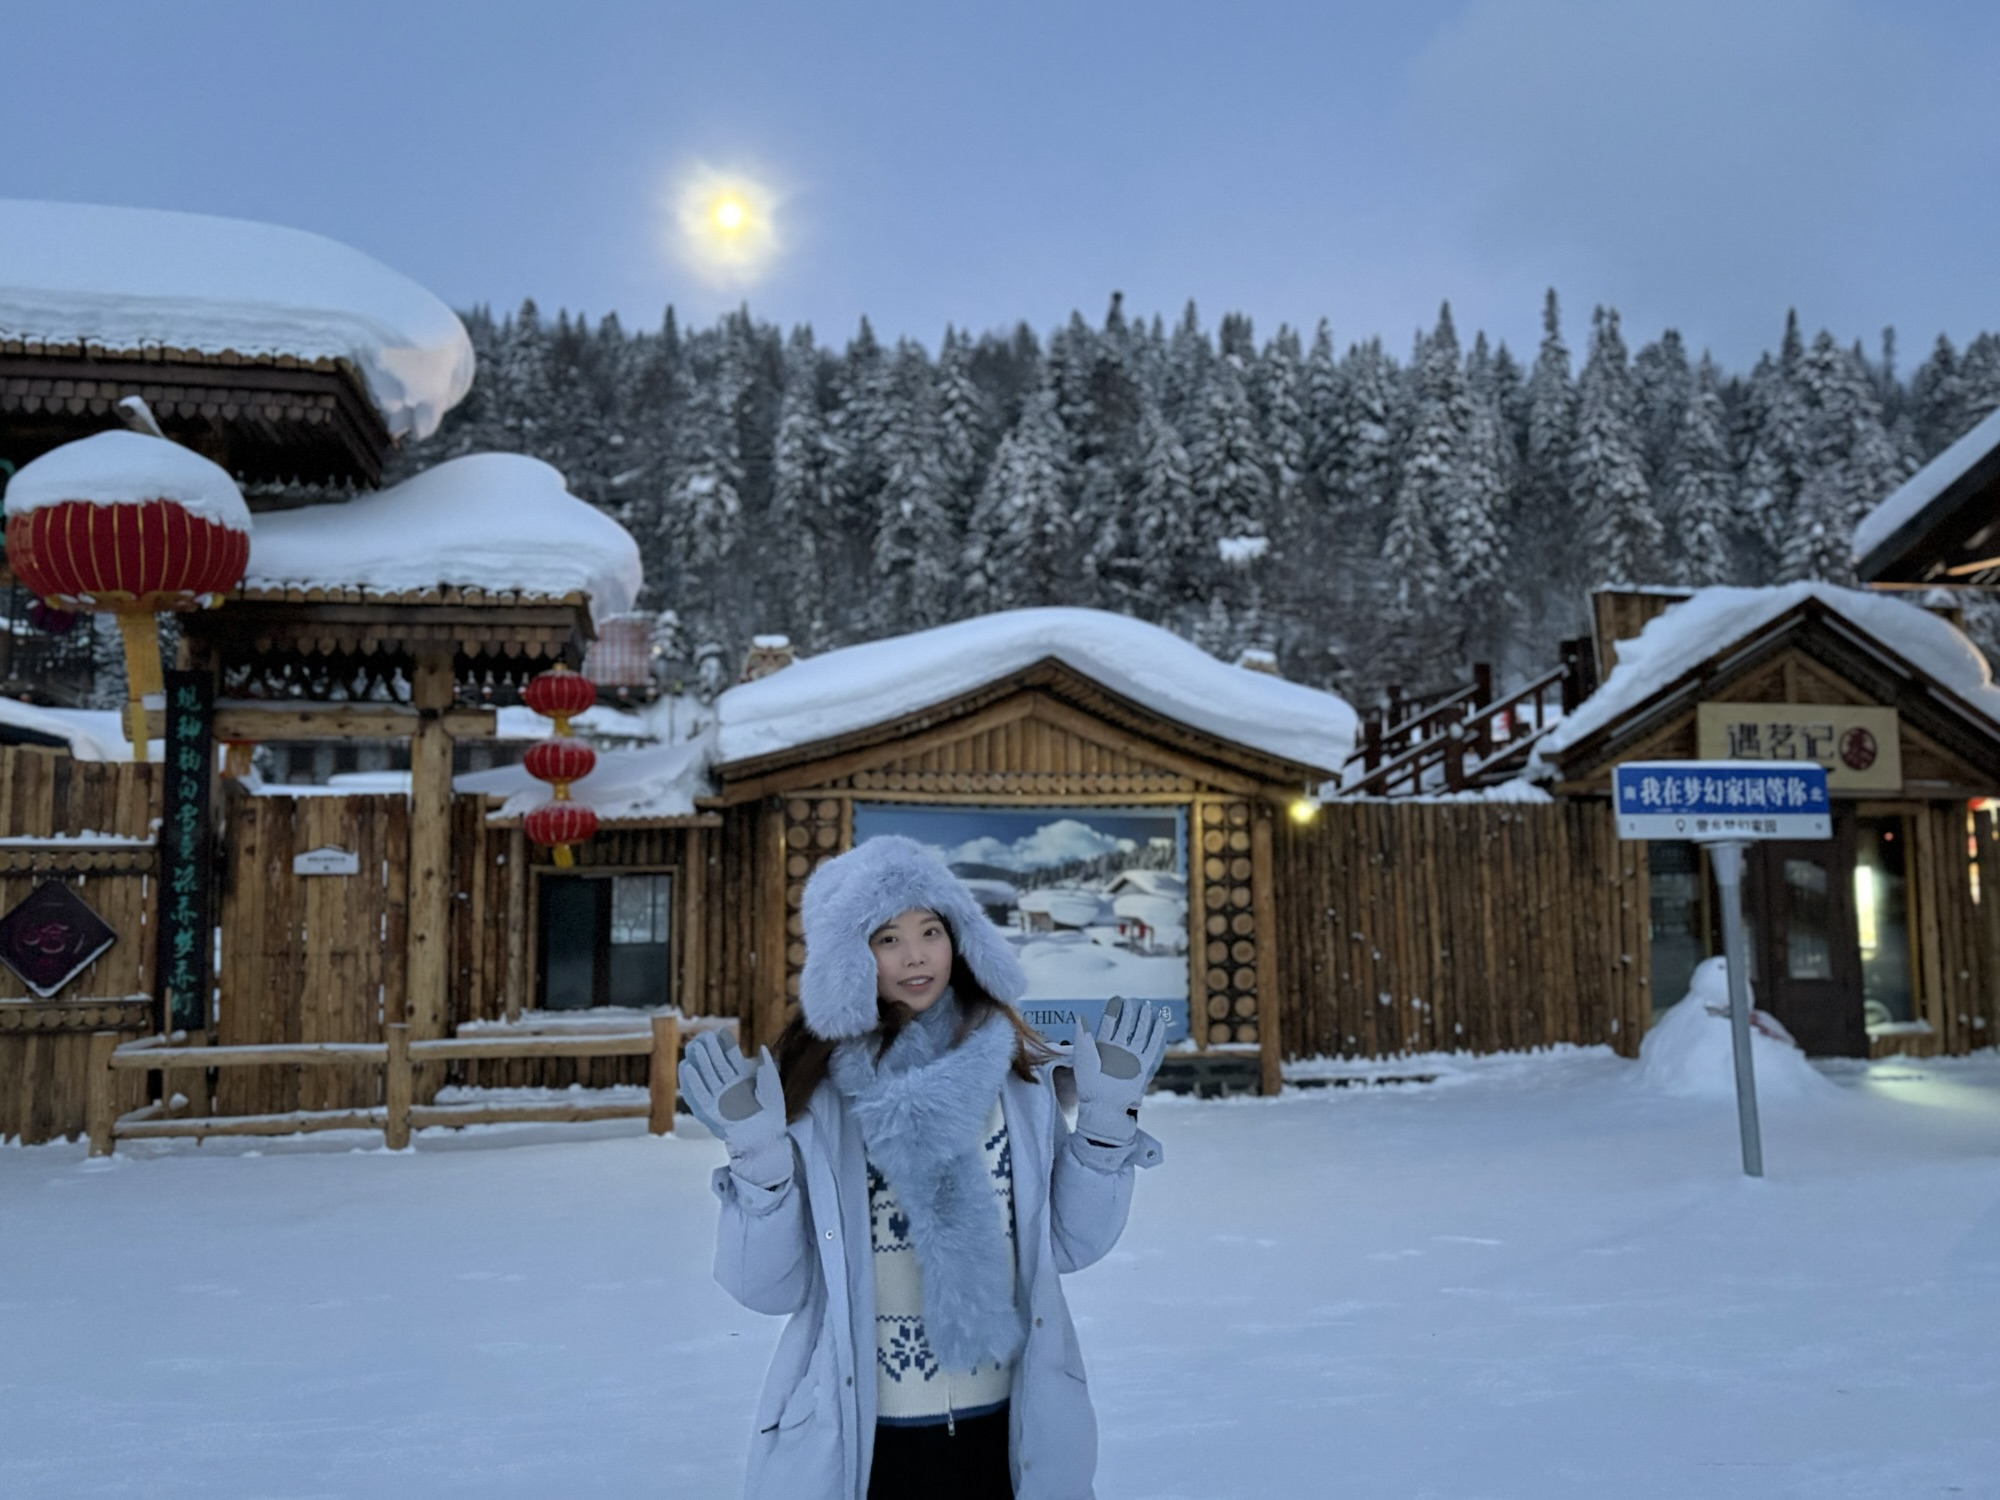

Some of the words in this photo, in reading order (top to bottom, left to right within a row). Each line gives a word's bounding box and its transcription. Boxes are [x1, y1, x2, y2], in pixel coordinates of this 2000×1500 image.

[1727, 722, 1834, 759] 遇茗记
[1623, 785, 1637, 801] 南
[1640, 775, 1808, 807] 我在梦幻家园等你
[1810, 786, 1824, 802] 北
[1023, 1010, 1077, 1025] CHINA
